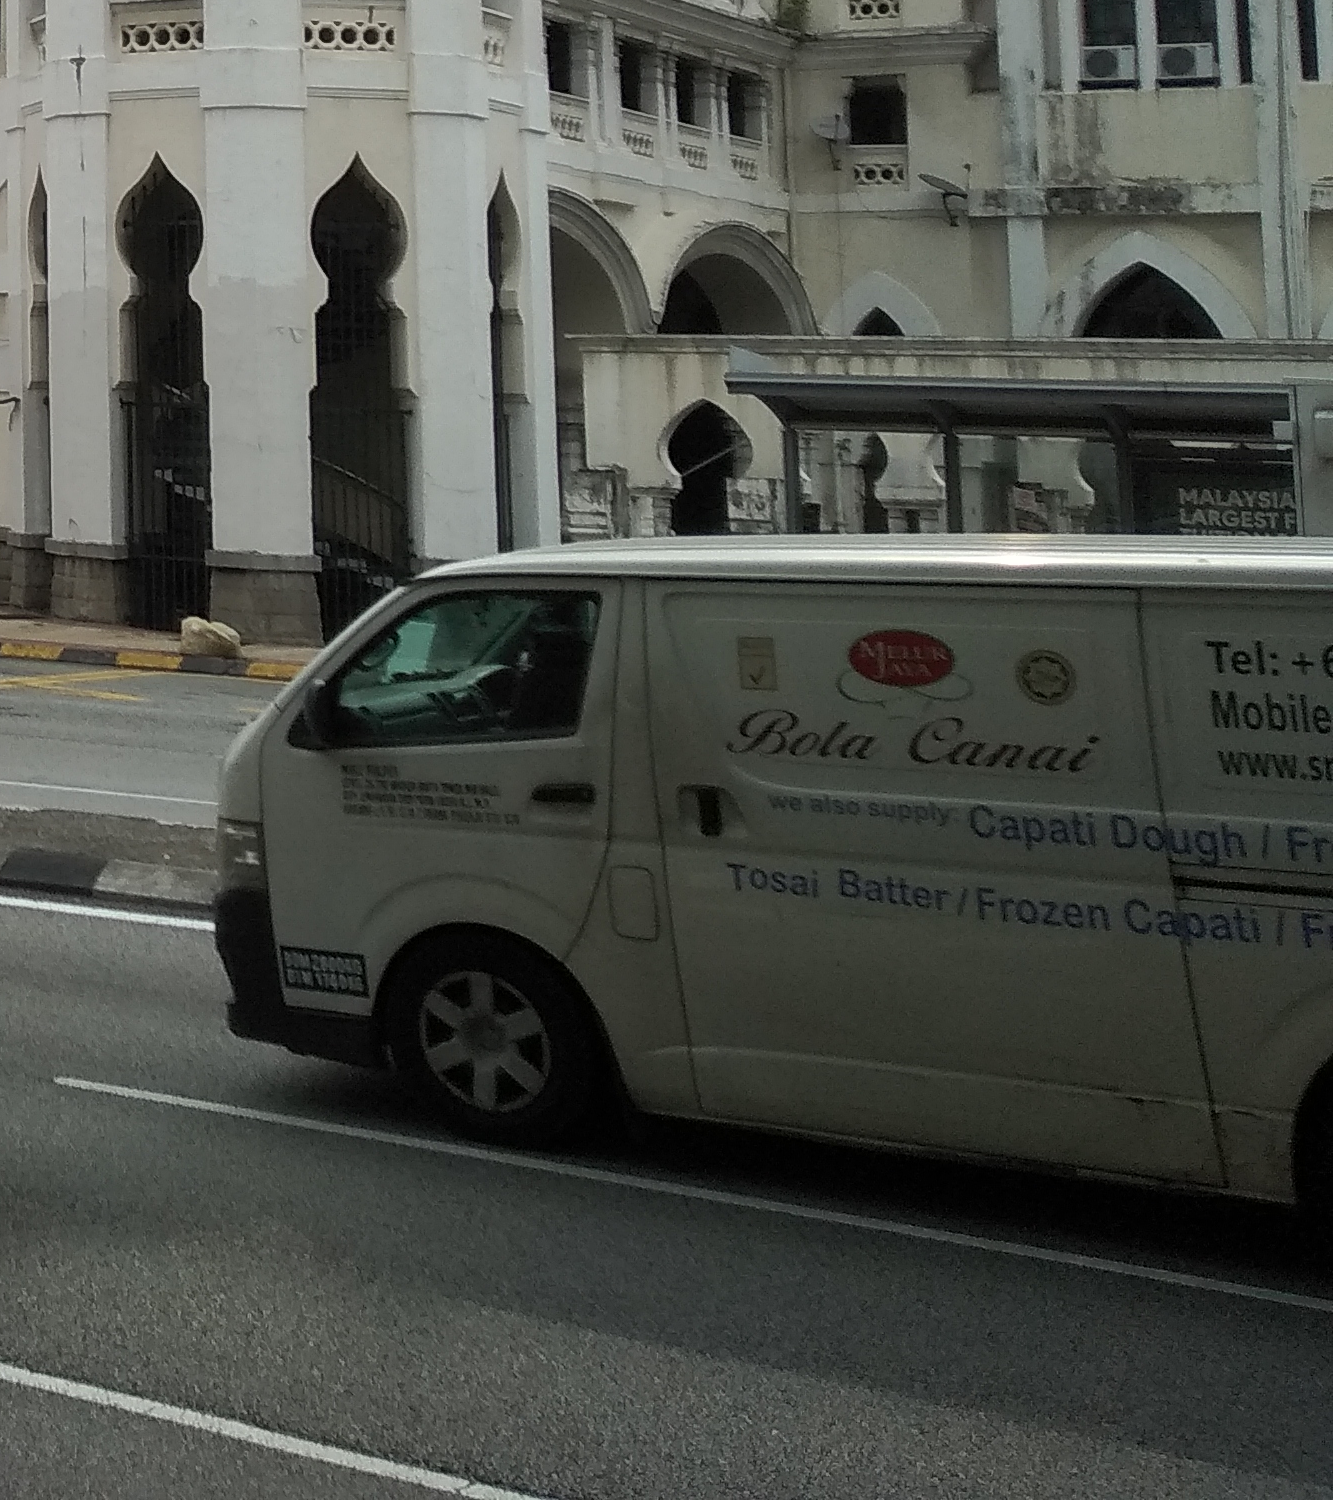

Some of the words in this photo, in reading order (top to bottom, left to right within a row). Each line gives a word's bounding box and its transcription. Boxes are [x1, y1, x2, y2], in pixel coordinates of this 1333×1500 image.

[1179, 508, 1279, 529] LARGEST
[1205, 640, 1280, 677] Tel:
[1209, 688, 1333, 734] Mobile
[725, 709, 879, 761] Bola
[907, 716, 1101, 773] Canai
[767, 792, 802, 812] we
[808, 793, 861, 816] also
[968, 803, 1097, 851] Capati
[1110, 813, 1248, 868] Dough
[725, 861, 819, 898] Tosai
[839, 867, 951, 912] Batter
[977, 887, 1112, 932] Frozen
[1124, 898, 1263, 946] Capati
